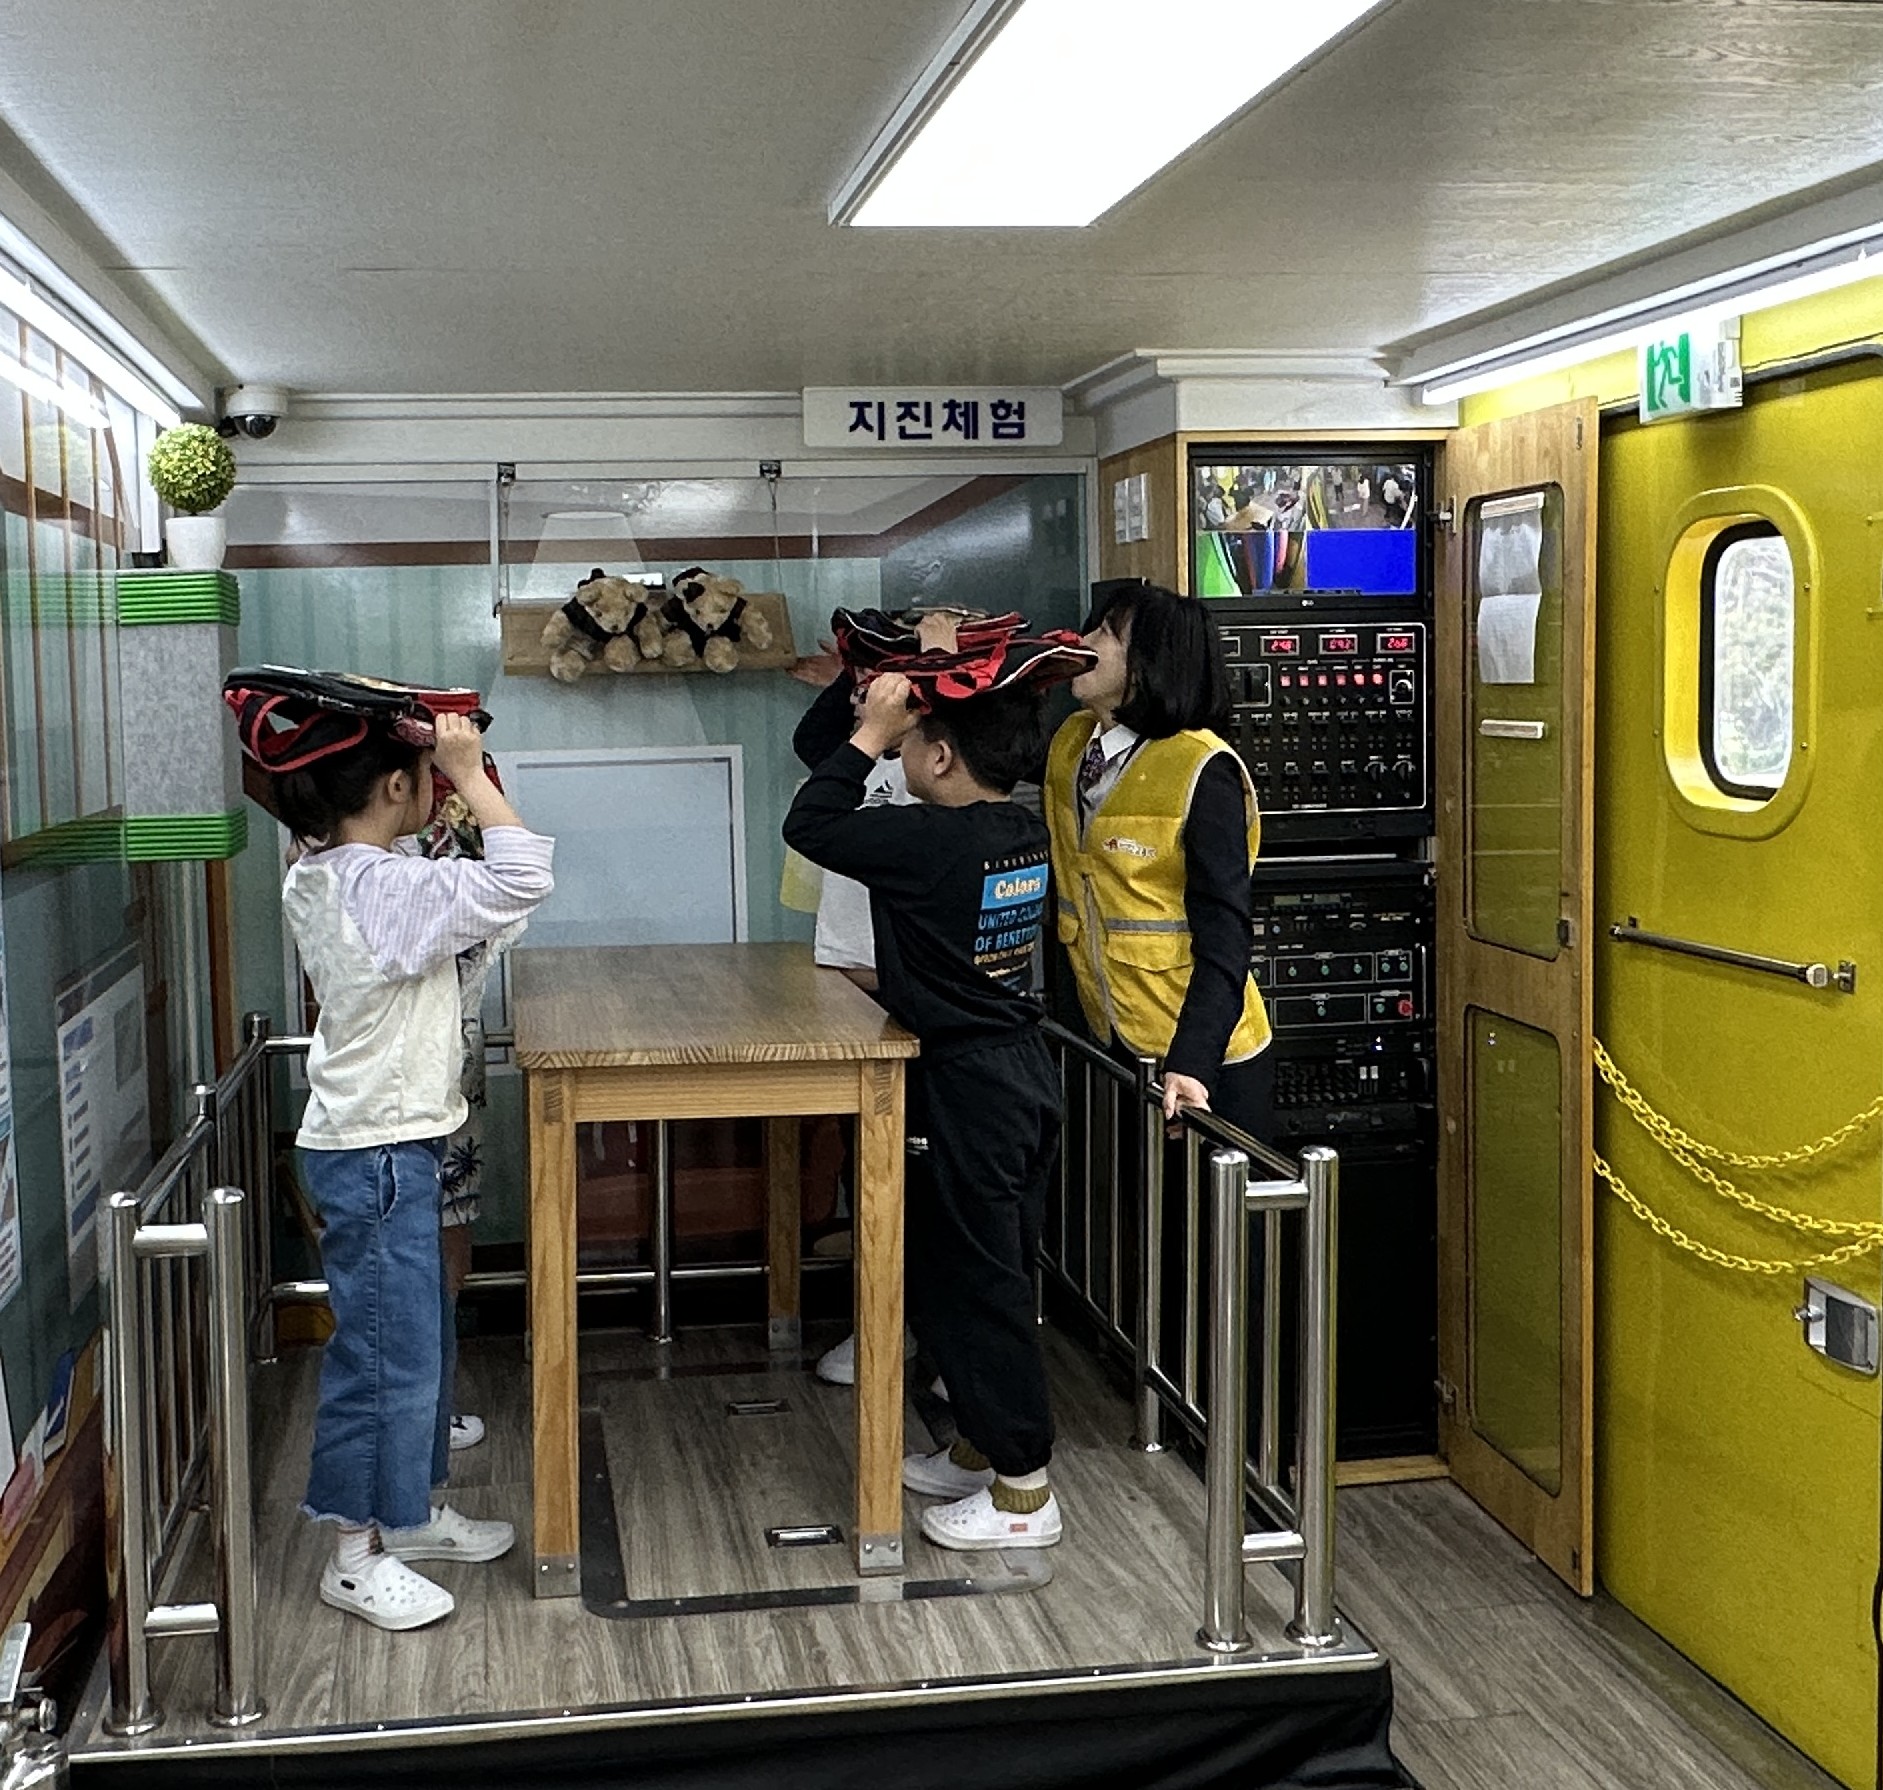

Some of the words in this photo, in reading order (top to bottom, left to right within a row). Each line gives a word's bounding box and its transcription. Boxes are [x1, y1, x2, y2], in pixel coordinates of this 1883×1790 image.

[848, 399, 1027, 441] 지진체험
[994, 876, 1041, 900] Colors
[974, 935, 993, 953] OF
